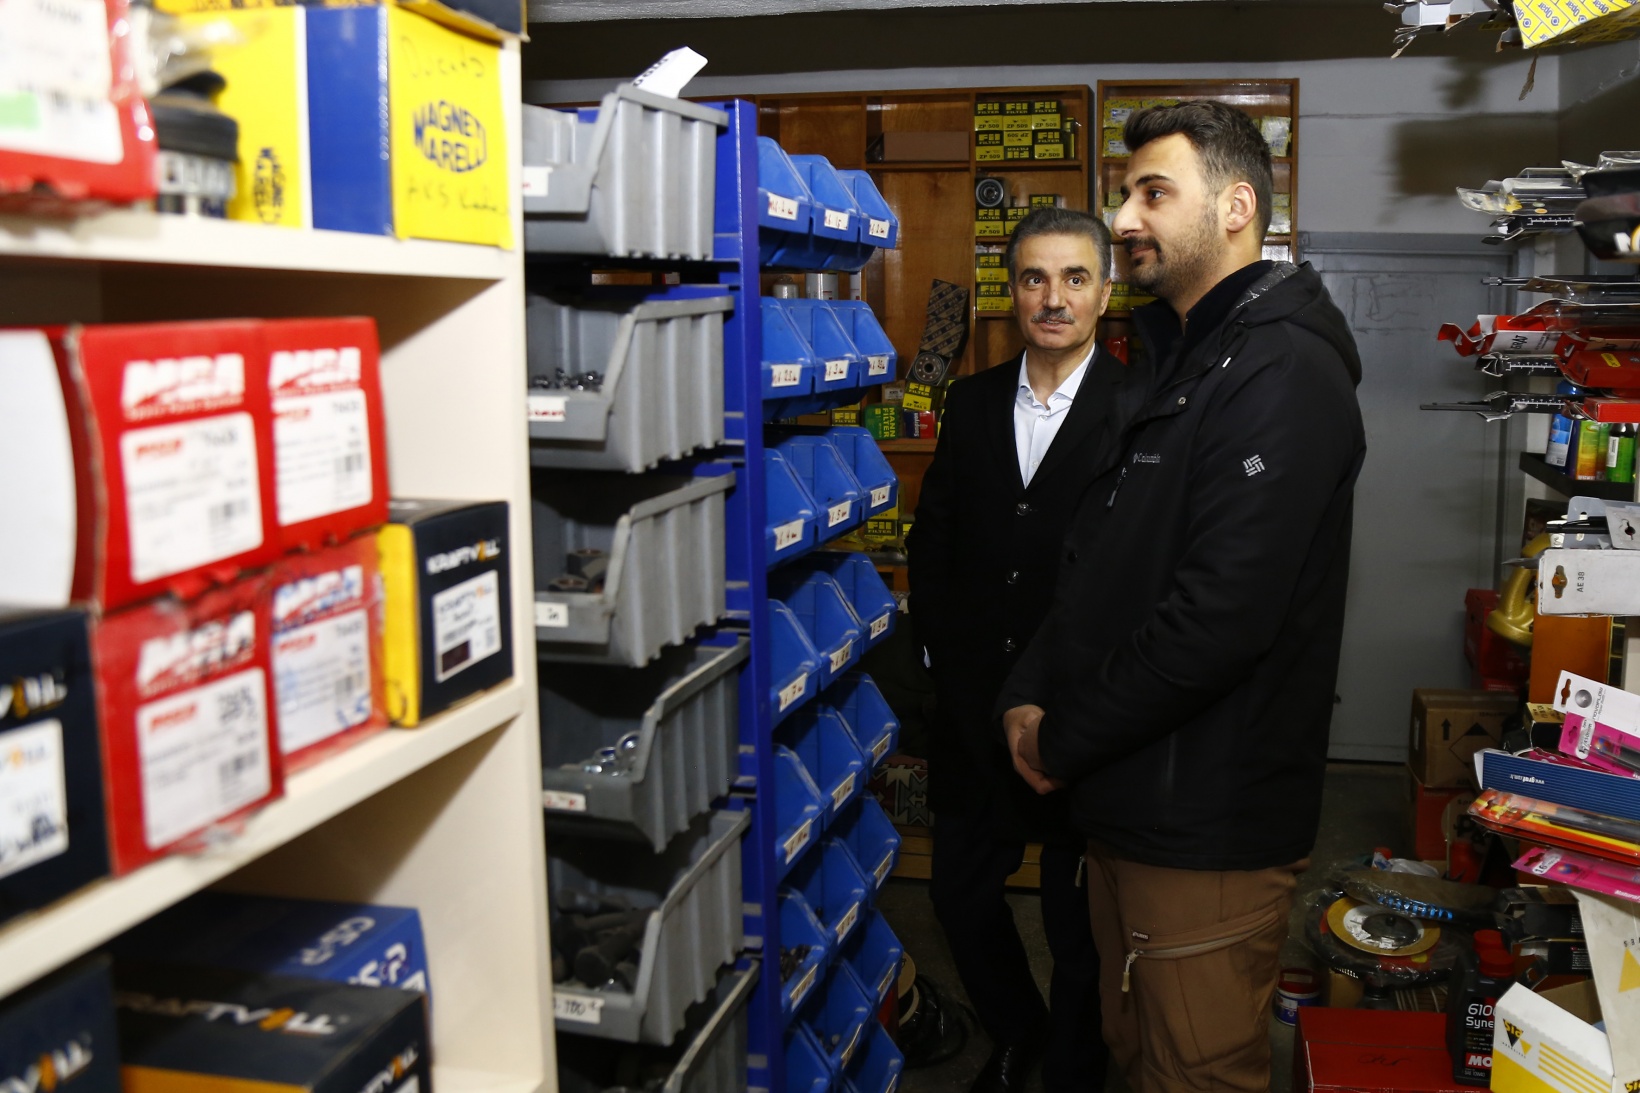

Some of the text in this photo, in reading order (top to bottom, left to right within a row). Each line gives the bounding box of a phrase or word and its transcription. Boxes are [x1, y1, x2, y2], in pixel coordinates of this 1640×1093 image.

[1577, 571, 1585, 592] AE 38
[1503, 1021, 1522, 1038] sia
